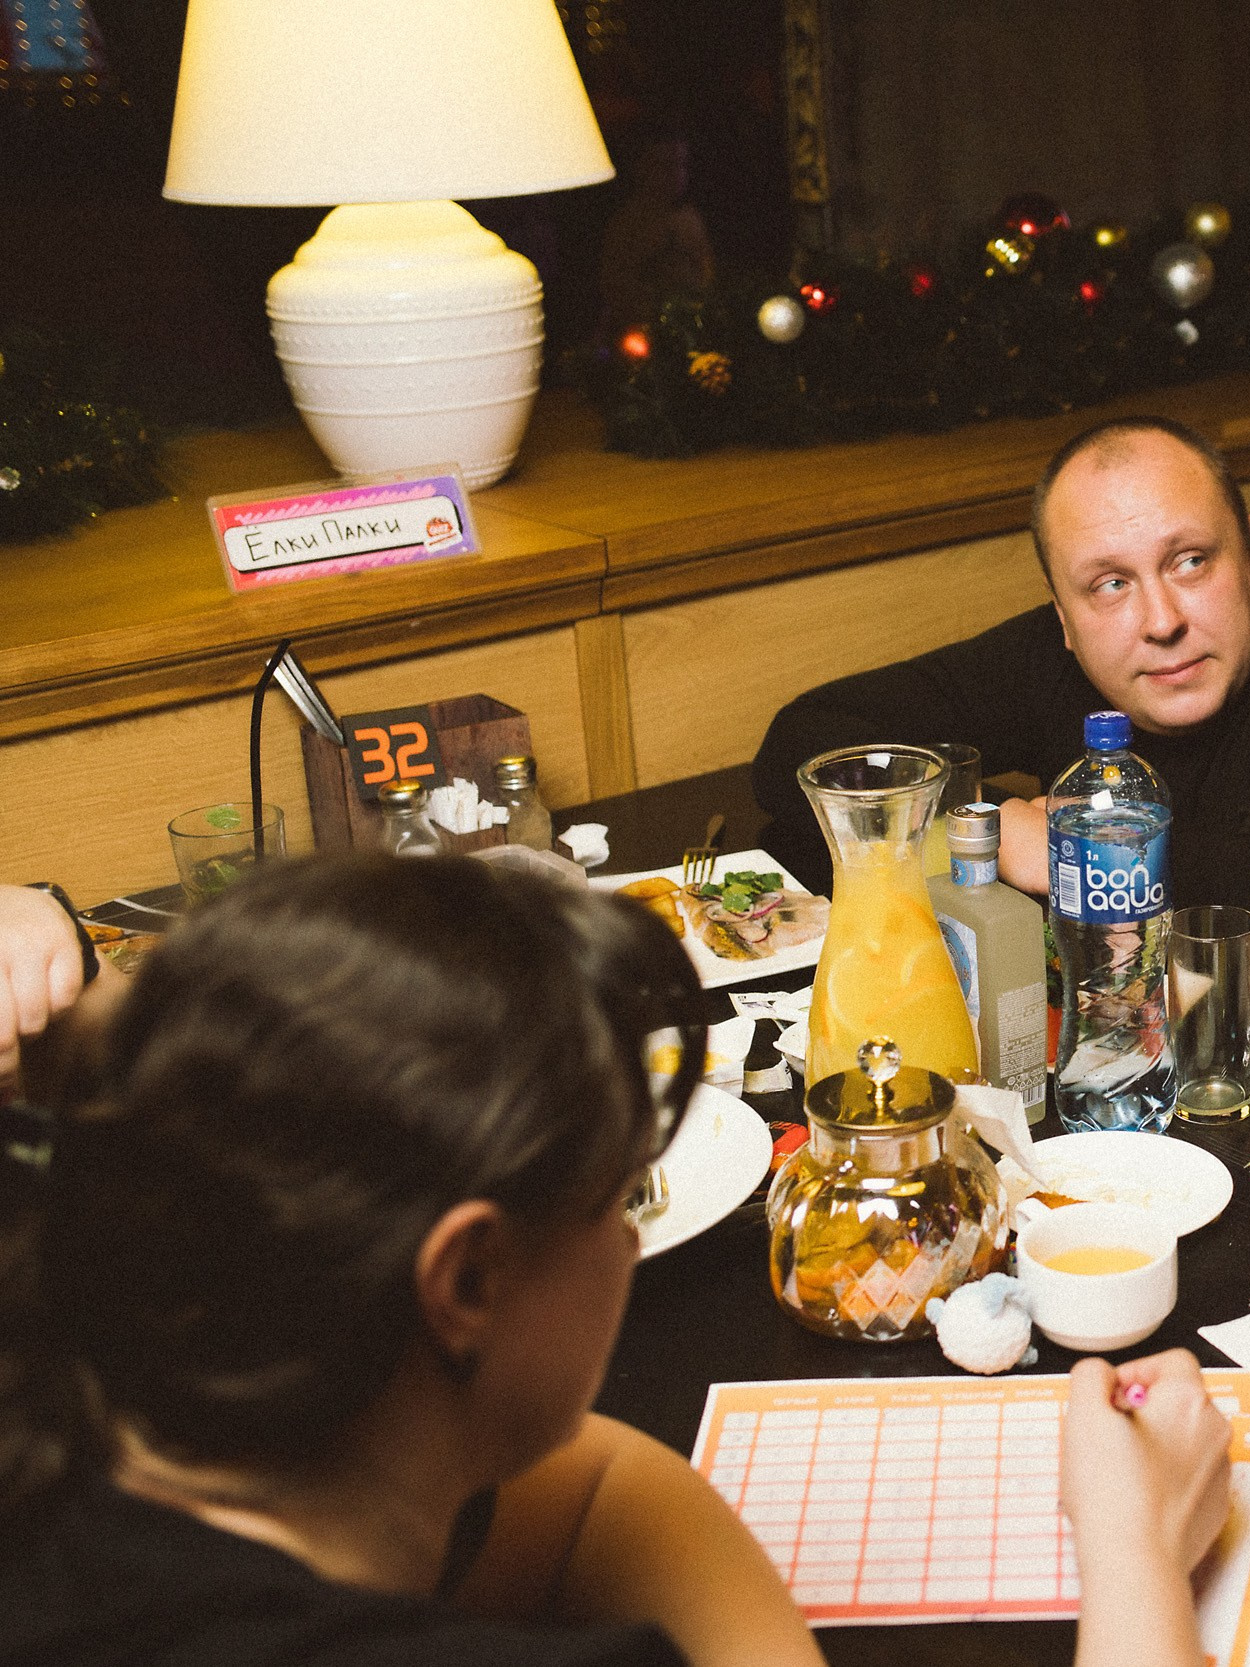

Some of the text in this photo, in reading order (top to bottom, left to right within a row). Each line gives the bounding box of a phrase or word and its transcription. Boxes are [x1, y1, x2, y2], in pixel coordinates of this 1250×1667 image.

[353, 721, 436, 785] 32
[1086, 863, 1150, 890] bon
[1087, 882, 1164, 914] aqua
